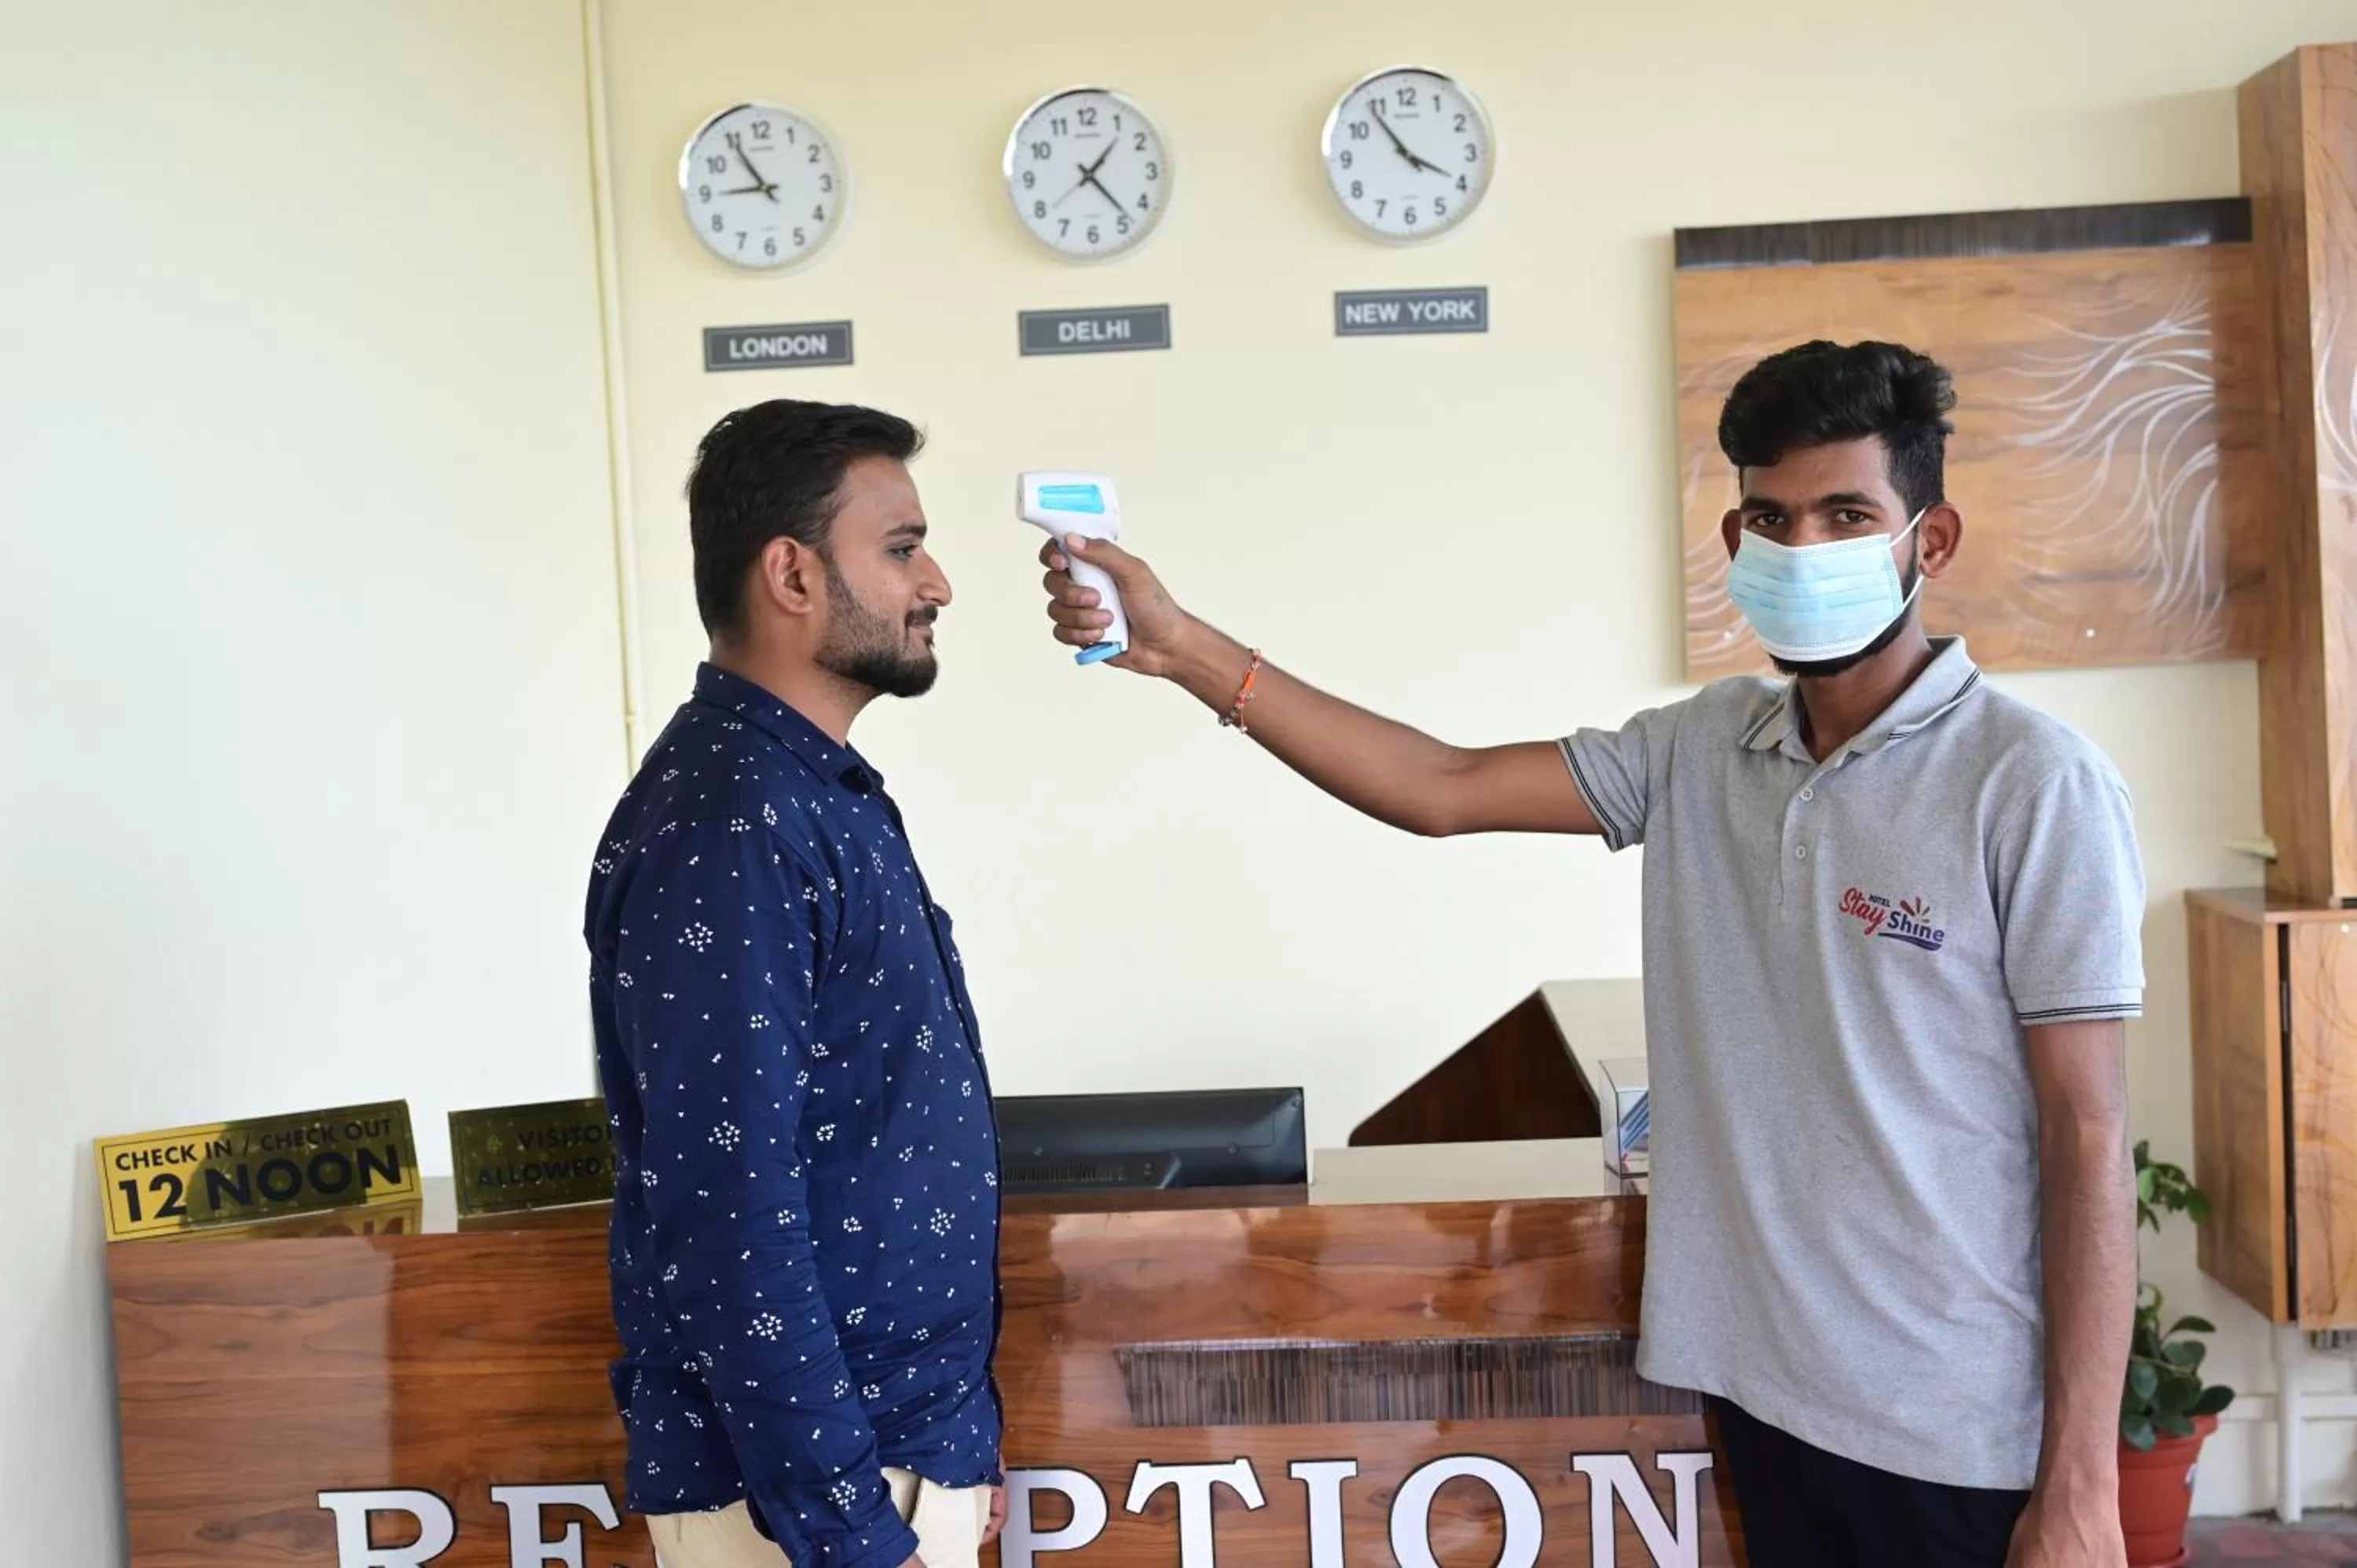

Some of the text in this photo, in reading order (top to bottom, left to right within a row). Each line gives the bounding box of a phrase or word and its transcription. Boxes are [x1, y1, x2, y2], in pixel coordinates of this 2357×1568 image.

[1368, 97, 1386, 115] 11
[1396, 87, 1417, 106] 12
[1432, 95, 1440, 112] 1
[1077, 107, 1097, 126] 12
[1113, 114, 1121, 132] 1
[1454, 113, 1466, 133] 2
[751, 121, 770, 139] 12
[786, 126, 795, 145] 1
[1051, 119, 1067, 136] 11
[1348, 121, 1369, 140] 10
[726, 131, 741, 149] 11
[1134, 132, 1146, 151] 2
[808, 145, 820, 163] 2
[1031, 141, 1051, 159] 10
[1464, 143, 1476, 162] 3
[706, 156, 726, 174] 10
[1340, 151, 1352, 169] 9
[1022, 171, 1035, 189] 9
[1146, 162, 1157, 180] 3
[819, 174, 832, 192] 3
[1351, 180, 1363, 200] 8
[1455, 174, 1467, 192] 4
[698, 185, 711, 203] 9
[1137, 193, 1148, 211] 4
[812, 205, 824, 222] 4
[1034, 200, 1047, 219] 8
[1375, 200, 1387, 218] 7
[1434, 196, 1446, 215] 5
[711, 214, 724, 233] 8
[1116, 215, 1129, 234] 5
[1404, 206, 1417, 225] 6
[793, 227, 805, 246] 5
[1058, 218, 1070, 237] 7
[1087, 225, 1099, 244] 6
[735, 232, 747, 250] 7
[764, 237, 776, 256] 6
[1344, 299, 1475, 324] NEW YORK
[1058, 319, 1131, 343] DELHI
[729, 333, 827, 360] LONDON
[1868, 894, 1891, 907] HOTEL
[1838, 887, 1886, 935] Stay
[1887, 910, 1945, 943] Shine
[115, 1119, 391, 1171] CHECK IN / CHECK OUT
[477, 1157, 600, 1189] ALLOWED
[119, 1143, 401, 1223] 12 NOON
[317, 1451, 1714, 1568] REPTION
